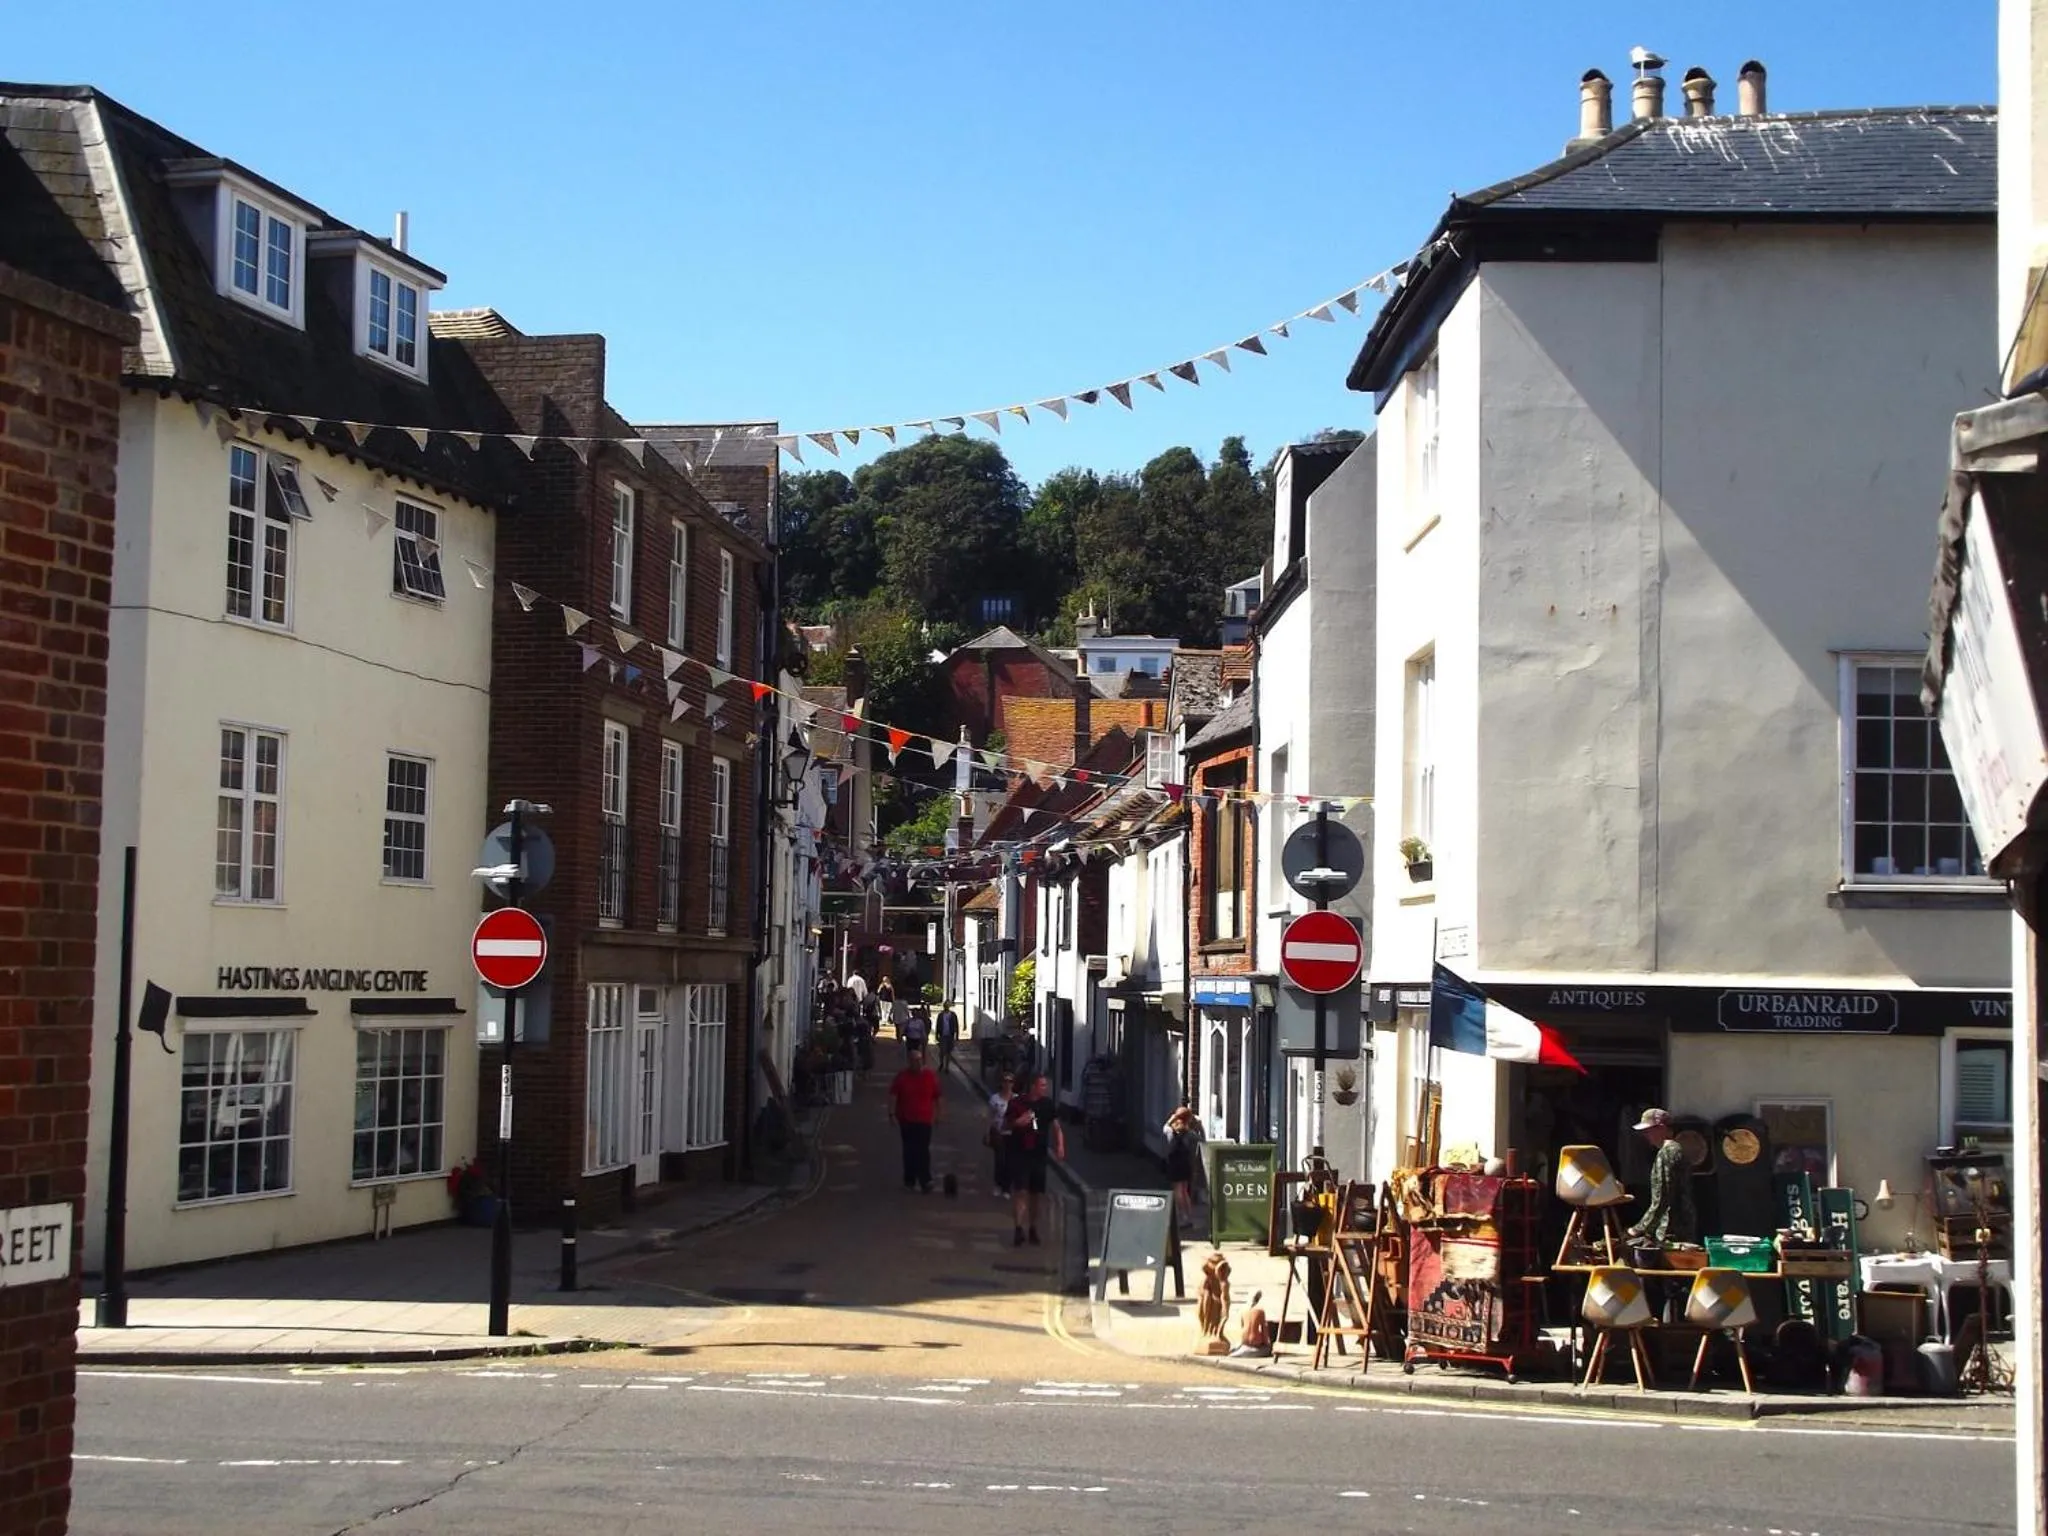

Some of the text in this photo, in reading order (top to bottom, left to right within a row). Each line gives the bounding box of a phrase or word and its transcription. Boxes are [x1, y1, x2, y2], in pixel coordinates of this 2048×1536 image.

[218, 966, 429, 991] HASTINGS ANGLING CENTRE
[1548, 989, 1646, 1009] ANTIQUES
[1737, 994, 1879, 1014] URBANRAID
[1969, 1000, 2012, 1016] VIN
[1773, 1015, 1843, 1028] TRADING
[1222, 1183, 1268, 1196] OPEN
